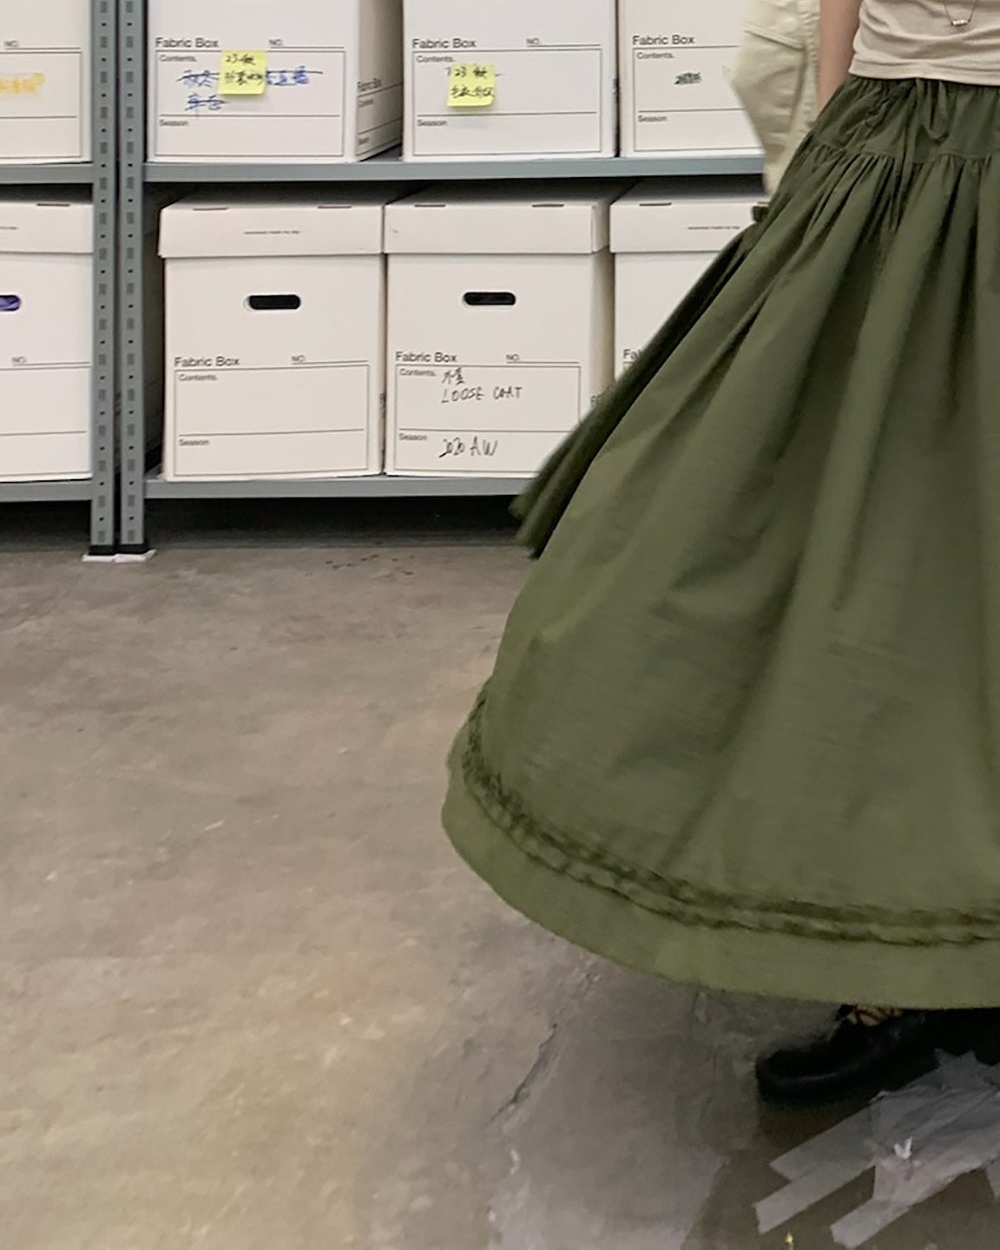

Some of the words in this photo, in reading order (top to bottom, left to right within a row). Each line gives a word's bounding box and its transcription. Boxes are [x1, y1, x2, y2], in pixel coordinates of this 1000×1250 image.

[156, 38, 191, 48] Fabric
[195, 38, 219, 48] Box
[412, 39, 449, 48] Fabric
[453, 39, 476, 48] Box
[632, 35, 668, 45] Fabric
[672, 35, 695, 44] Box
[174, 356, 212, 367] Fabric
[216, 356, 240, 366] Box
[396, 351, 431, 362] Fabric
[434, 352, 457, 362] Box
